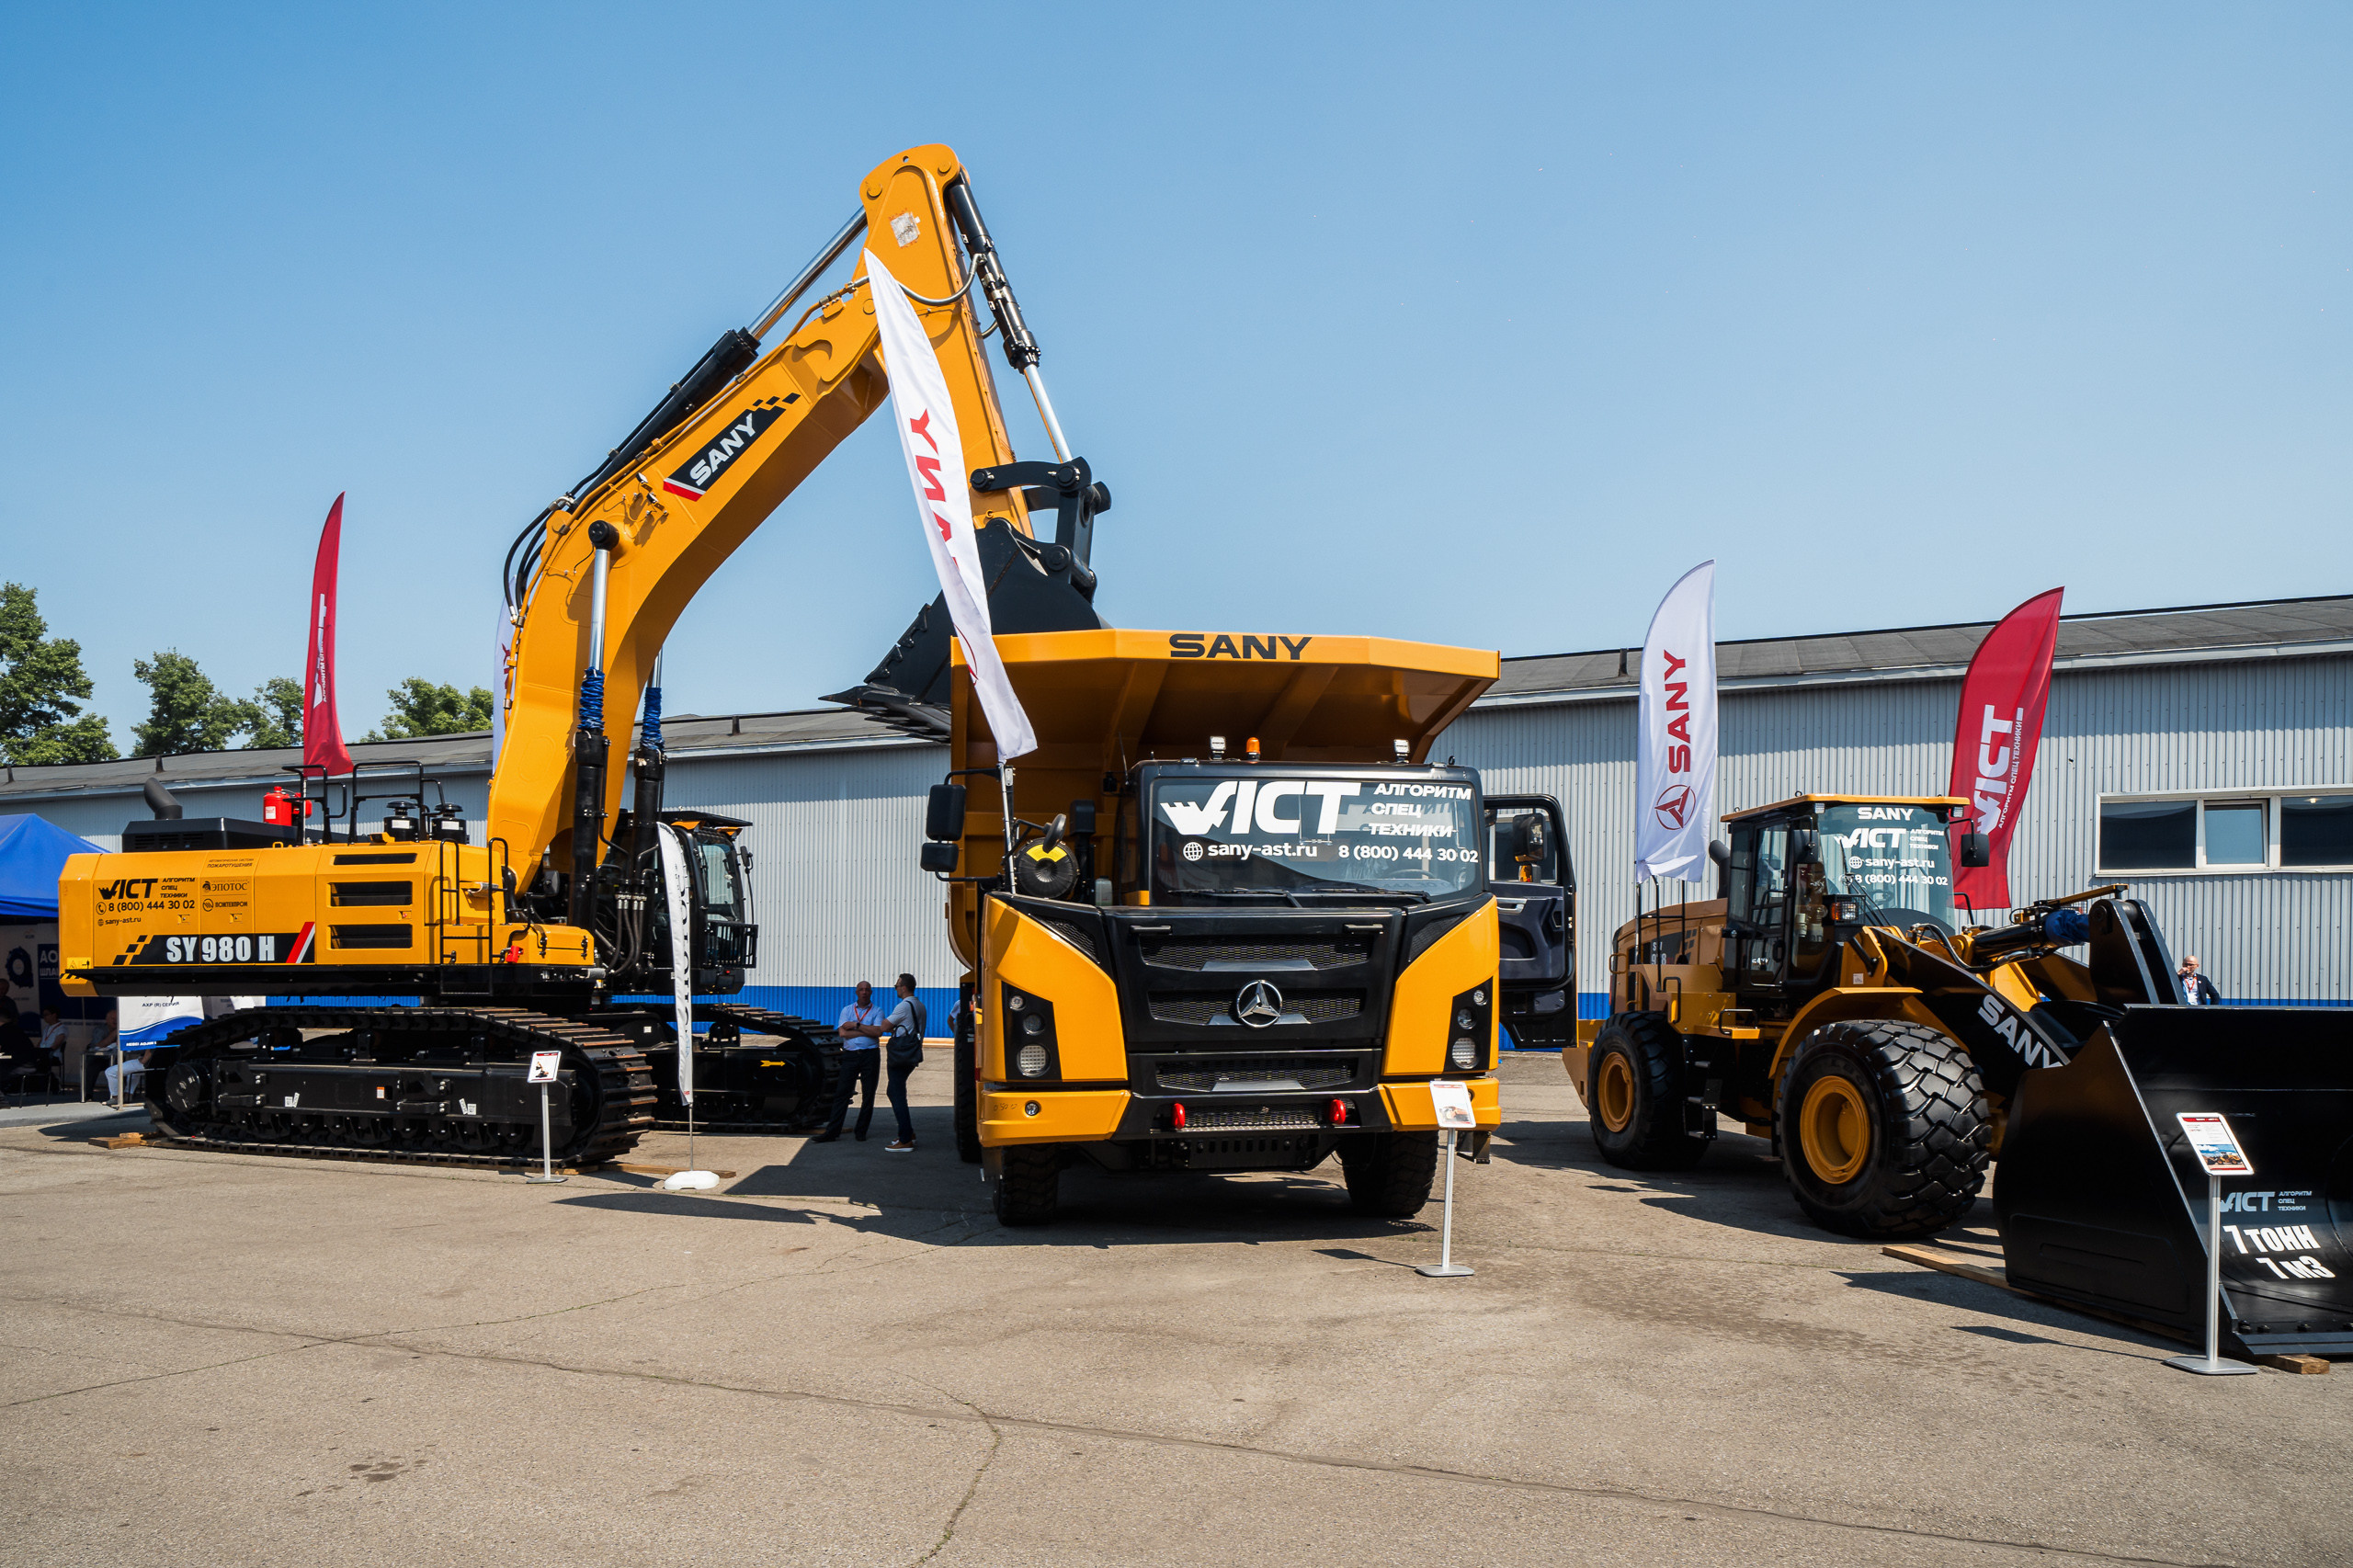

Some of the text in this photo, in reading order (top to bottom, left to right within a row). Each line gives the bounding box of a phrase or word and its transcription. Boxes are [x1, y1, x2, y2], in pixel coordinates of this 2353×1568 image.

[690, 413, 756, 487] SANY
[1169, 633, 1313, 661] SANY
[1664, 649, 1691, 774] SANY
[1997, 721, 2023, 829] АЛГОРИТМ СПЕЦ ТЕХНИКИ
[1373, 783, 1472, 801] АЛГОРИТМ
[1371, 802, 1422, 818] СПЕЦ
[1858, 807, 1914, 821] SANY
[1369, 823, 1453, 838] ТЕХНИКИ
[1208, 843, 1318, 861] sany-ast.ru
[1338, 845, 1479, 863] 8 (800) 444 30 02
[1865, 858, 1935, 870] sany-ast.ru
[211, 882, 248, 892] ЭПОТОС
[1865, 874, 1896, 885] (800)
[1898, 875, 1918, 884] 444
[1921, 875, 1935, 885] 30
[1936, 876, 1949, 886] 02
[108, 899, 196, 913] 8 (800) 444 30 02
[105, 916, 142, 926] sany-ast.ru
[1977, 994, 2063, 1069] SANY
